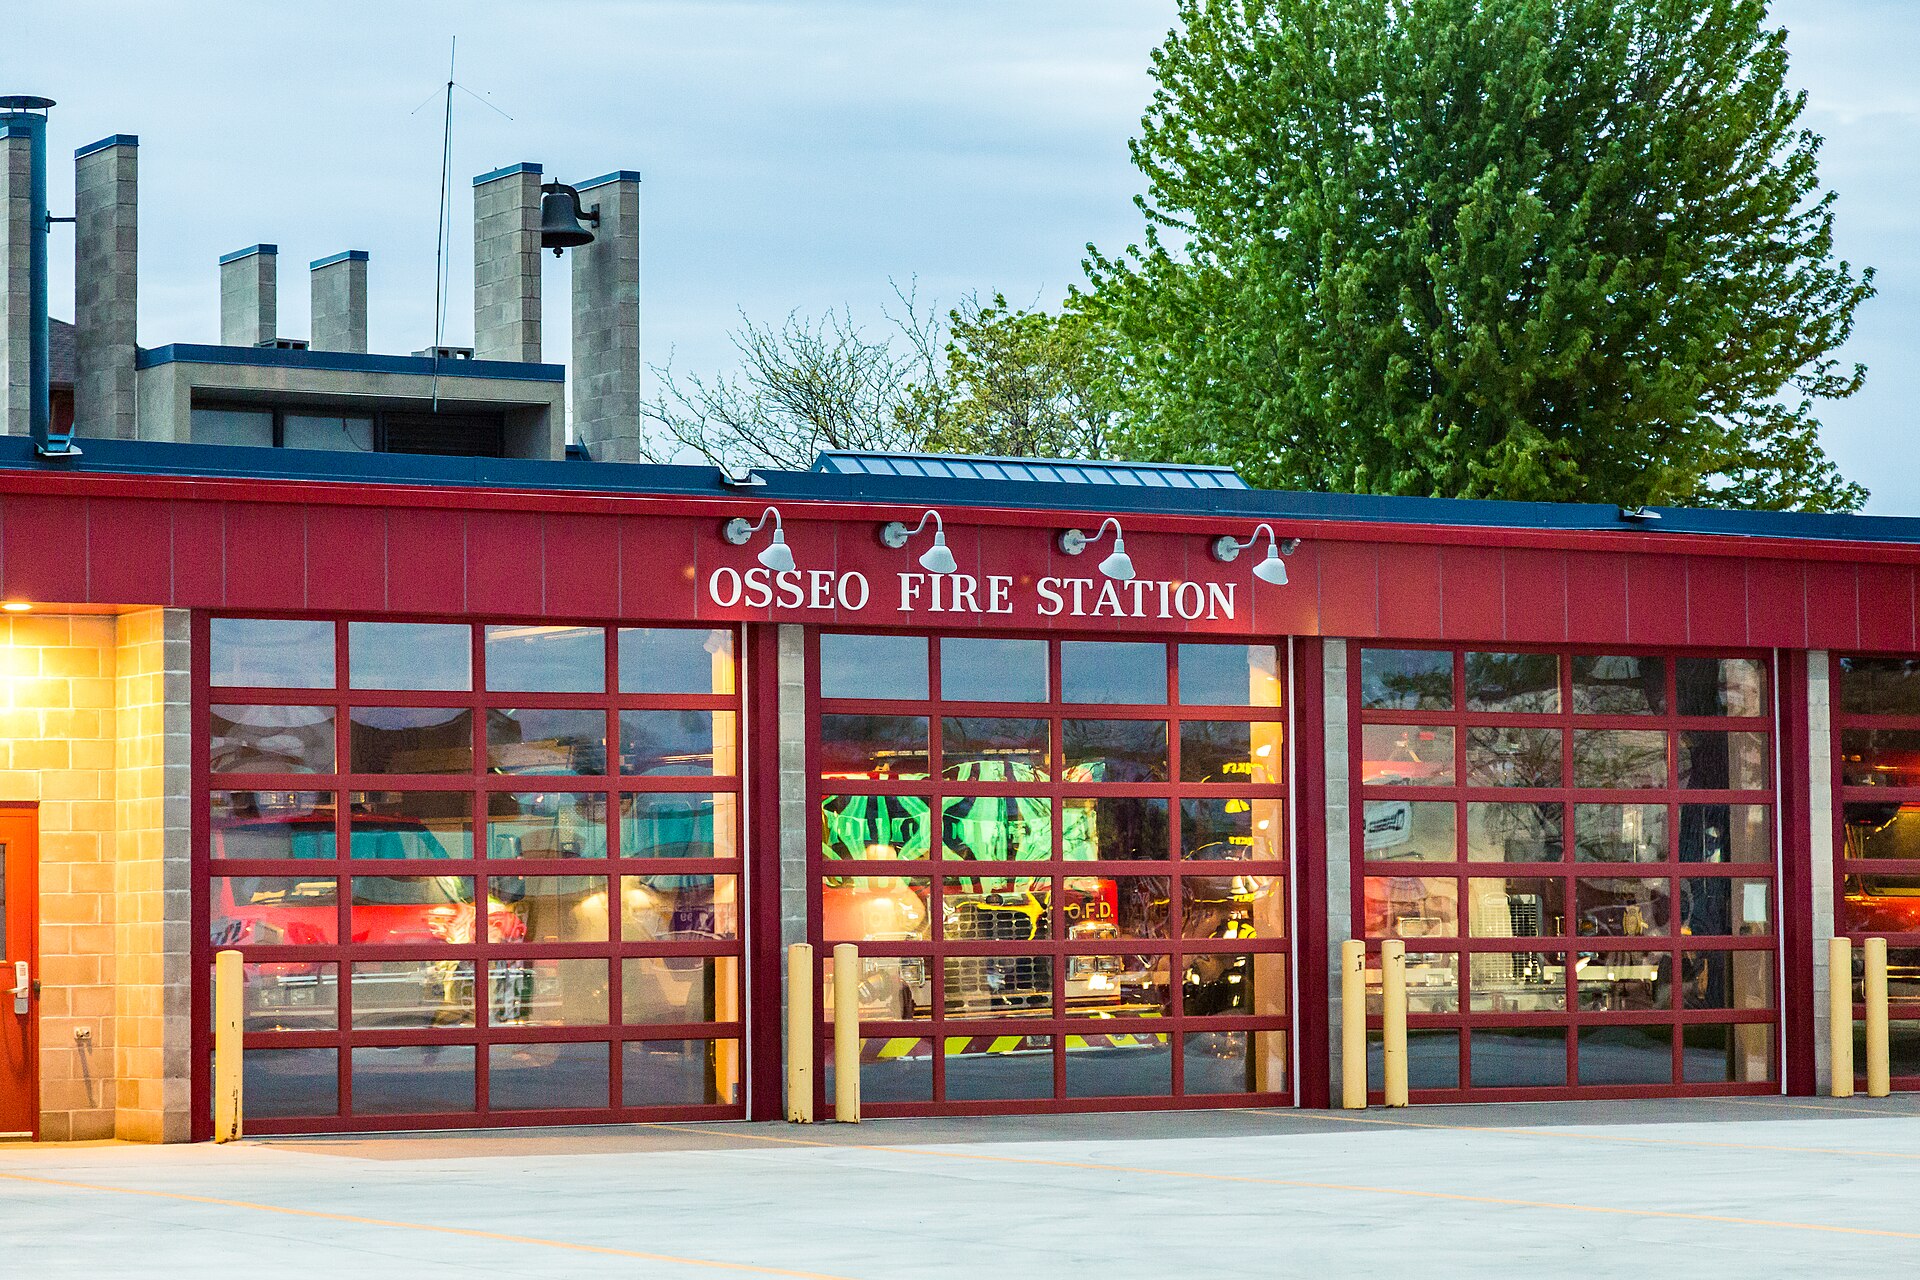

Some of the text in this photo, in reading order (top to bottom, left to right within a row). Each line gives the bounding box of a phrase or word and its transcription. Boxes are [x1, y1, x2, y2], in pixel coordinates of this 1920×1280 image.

[709, 567, 1237, 620] OSSEO FIRE STATION
[1067, 902, 1114, 919] O.F.D.
